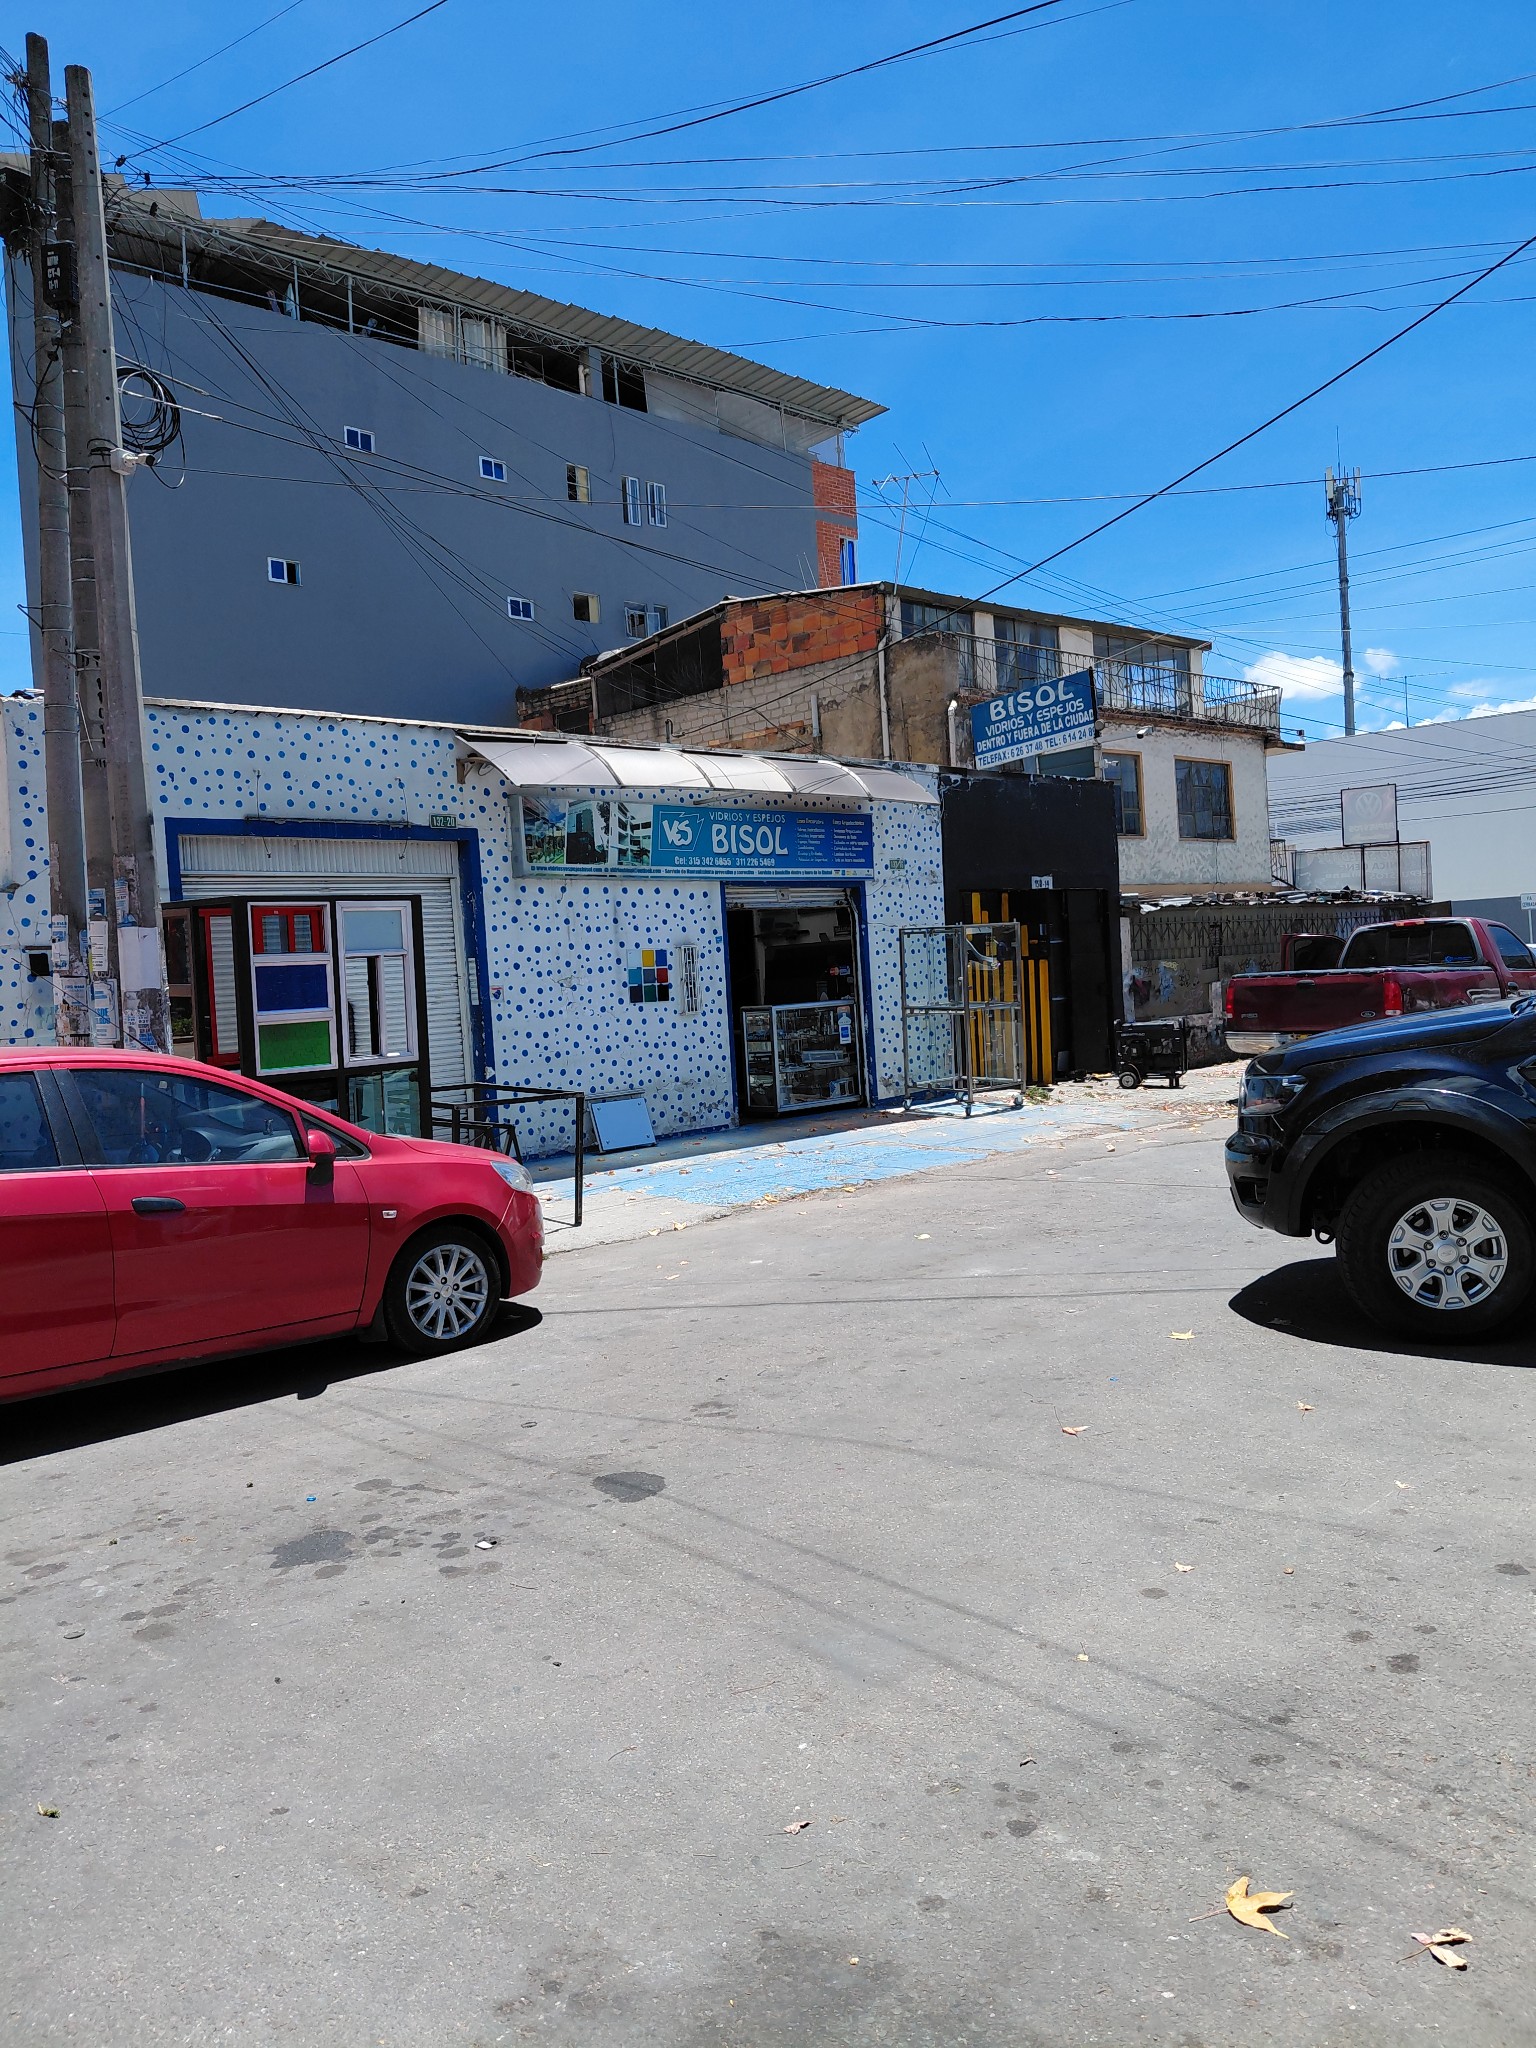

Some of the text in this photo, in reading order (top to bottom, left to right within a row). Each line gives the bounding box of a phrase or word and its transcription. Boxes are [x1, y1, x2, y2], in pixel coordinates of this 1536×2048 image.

[989, 680, 1074, 722] BISOL
[985, 698, 1085, 737] VIDRIOS Y ESPEJOS
[977, 709, 1095, 753] DENTRO Y FUERA DE LA CIUDAD
[1025, 743, 1033, 754] 37
[1045, 737, 1062, 749] TEL:
[433, 816, 455, 827] 132-20
[709, 811, 786, 824] VIDRIOS Y ESPEJOS
[711, 824, 789, 855] BISOL
[688, 856, 701, 866] 315
[701, 856, 714, 866] 342
[735, 857, 746, 867] 311
[746, 857, 759, 867] 226
